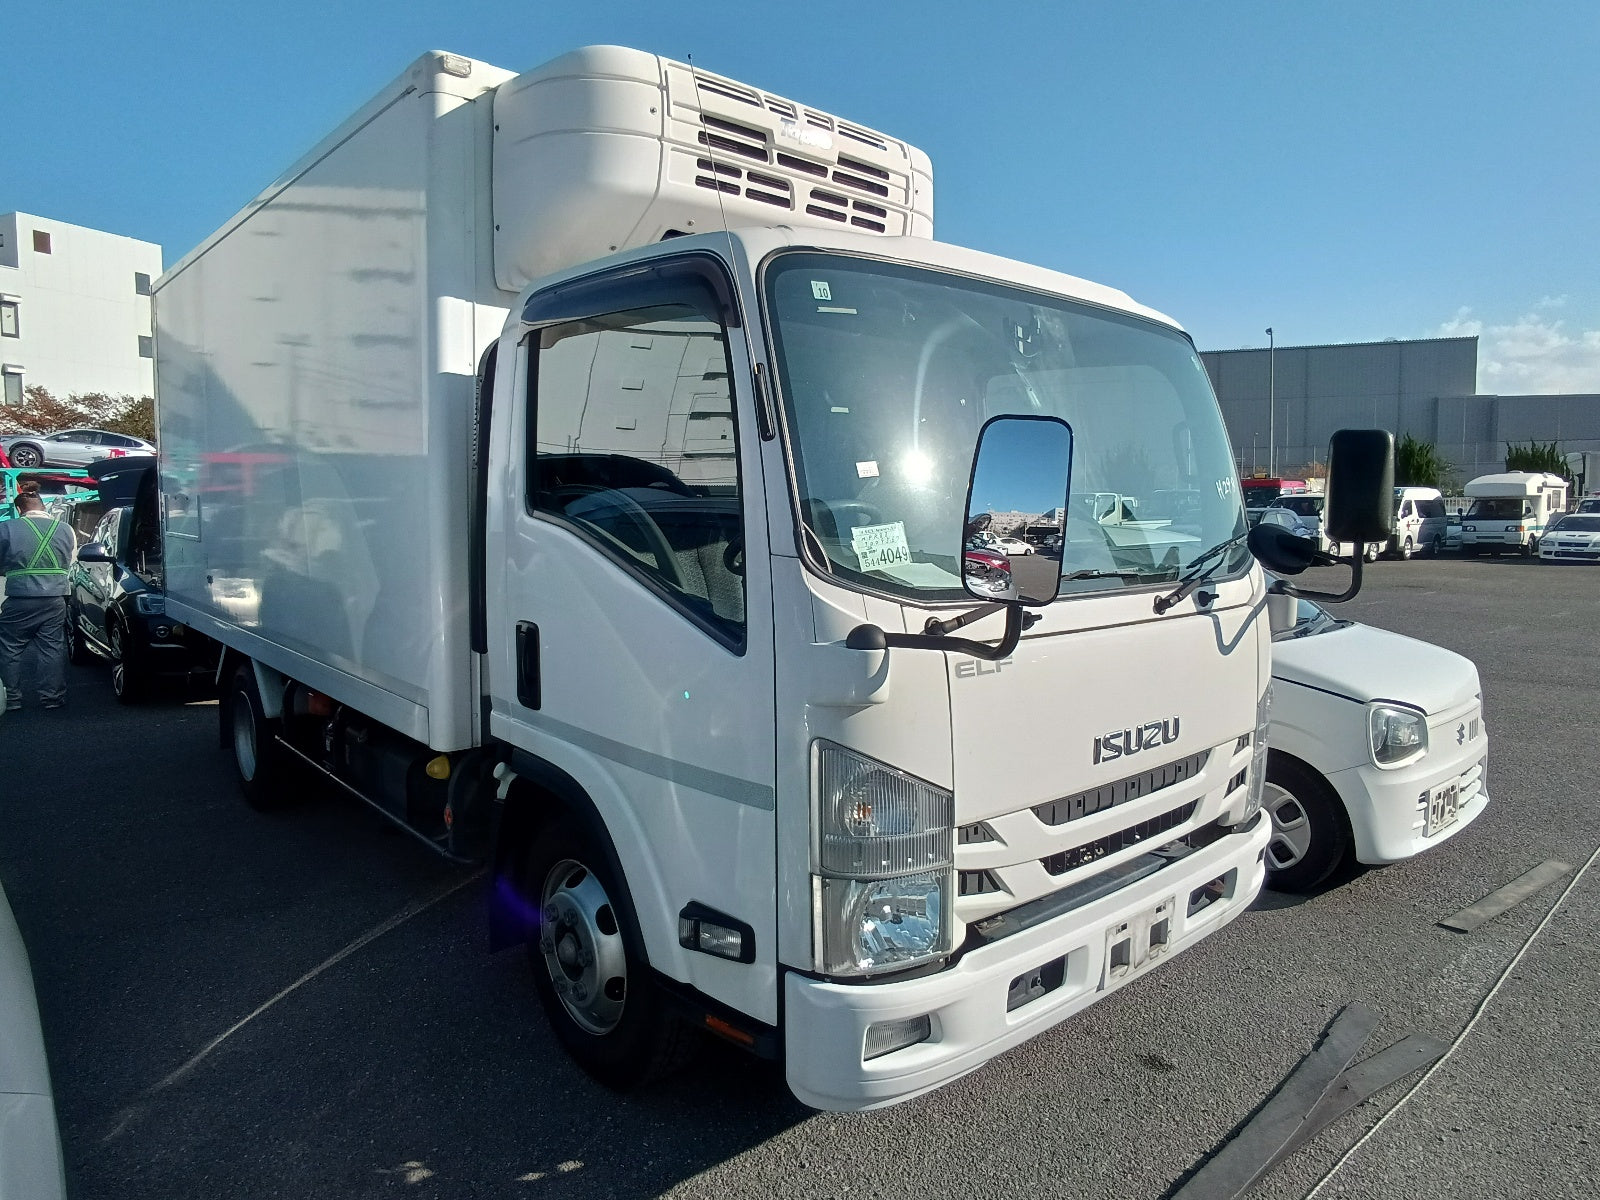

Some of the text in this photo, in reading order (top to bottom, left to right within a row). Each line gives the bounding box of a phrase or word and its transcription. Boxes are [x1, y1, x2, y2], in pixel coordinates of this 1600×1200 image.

[818, 287, 829, 299] 10
[880, 546, 909, 565] 4049
[955, 655, 1013, 679] ELF
[1092, 715, 1180, 765] ISUZU
